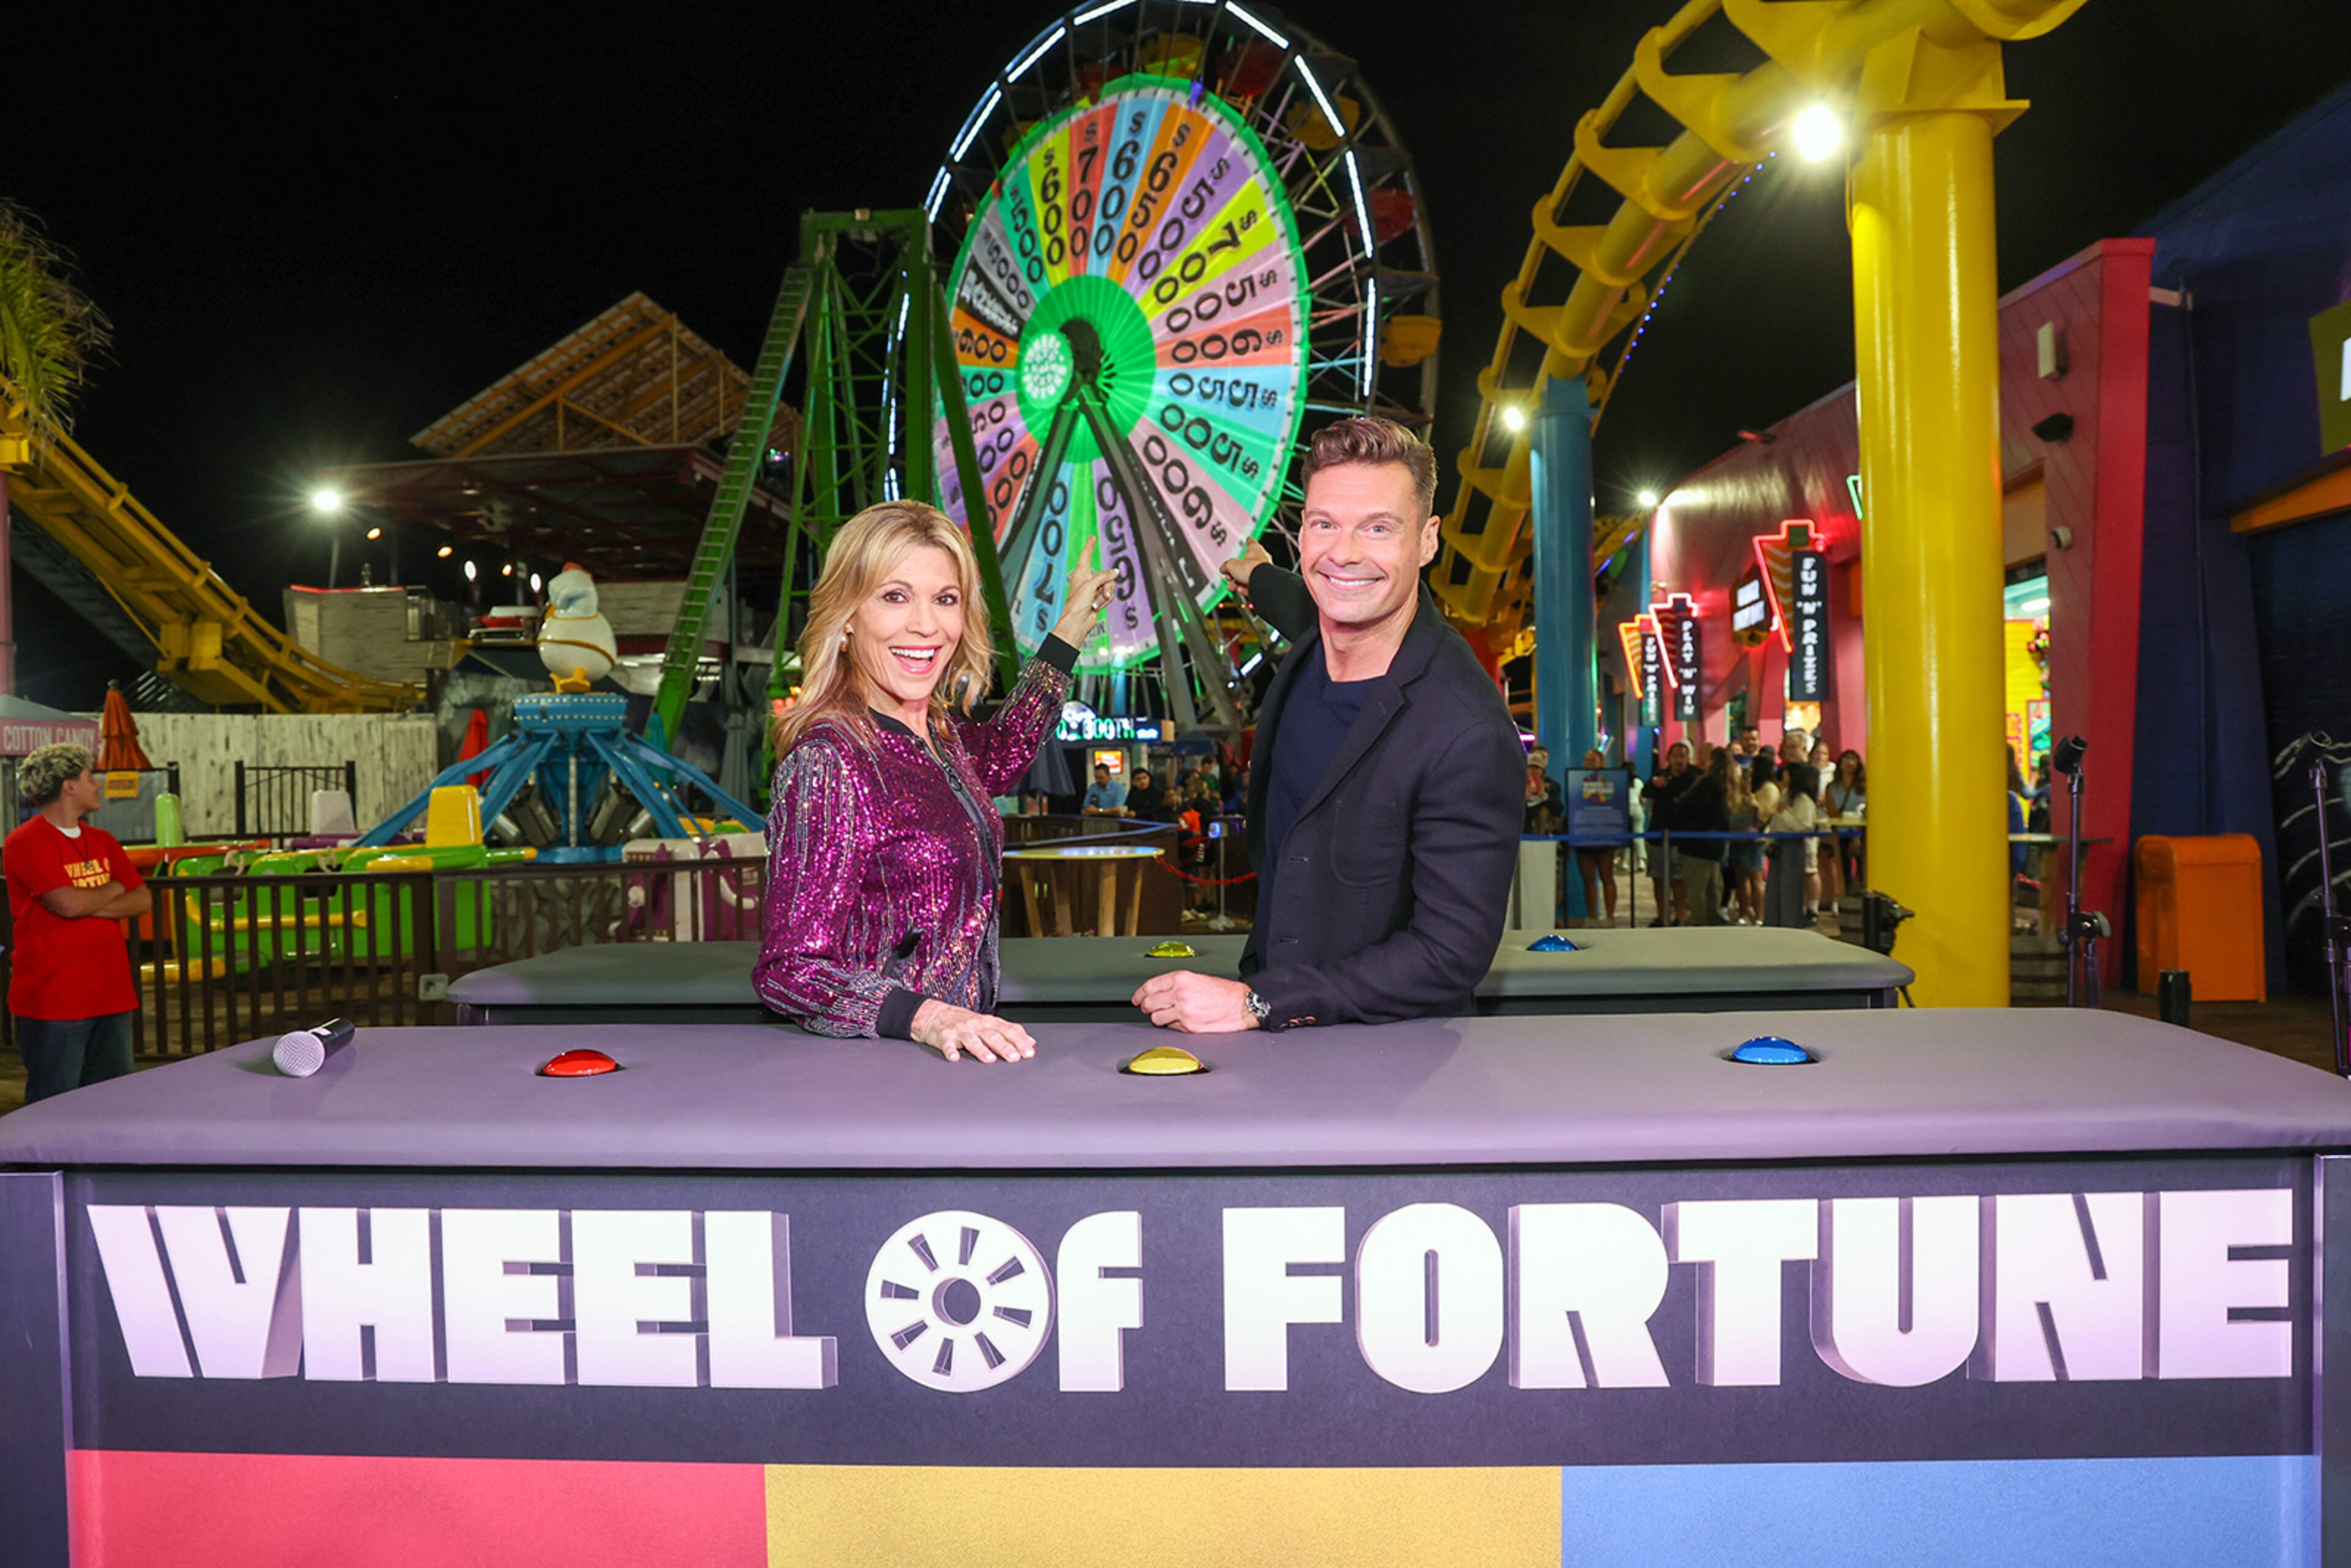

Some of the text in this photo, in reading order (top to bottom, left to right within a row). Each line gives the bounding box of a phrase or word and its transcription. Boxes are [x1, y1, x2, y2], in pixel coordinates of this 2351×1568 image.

[1041, 147, 1065, 266] $600
[1070, 121, 1098, 258] $700
[1095, 111, 1146, 256] $600
[1117, 123, 1191, 263] $650
[1138, 158, 1230, 280] $500
[1154, 210, 1258, 304] $700
[1166, 269, 1277, 333] $500
[1172, 329, 1283, 363] $600
[1169, 372, 1278, 408] $550
[1160, 403, 1259, 479] $500
[1143, 435, 1227, 547] $600
[1800, 557, 1818, 596] FUN
[1682, 620, 1694, 662] PLAY
[1801, 618, 1818, 694] PRIZES
[3, 725, 52, 751] COTTON
[1681, 685, 1697, 715] WIN
[86, 1204, 839, 1389] WHEEL
[1222, 1188, 2293, 1394] FORTUNE
